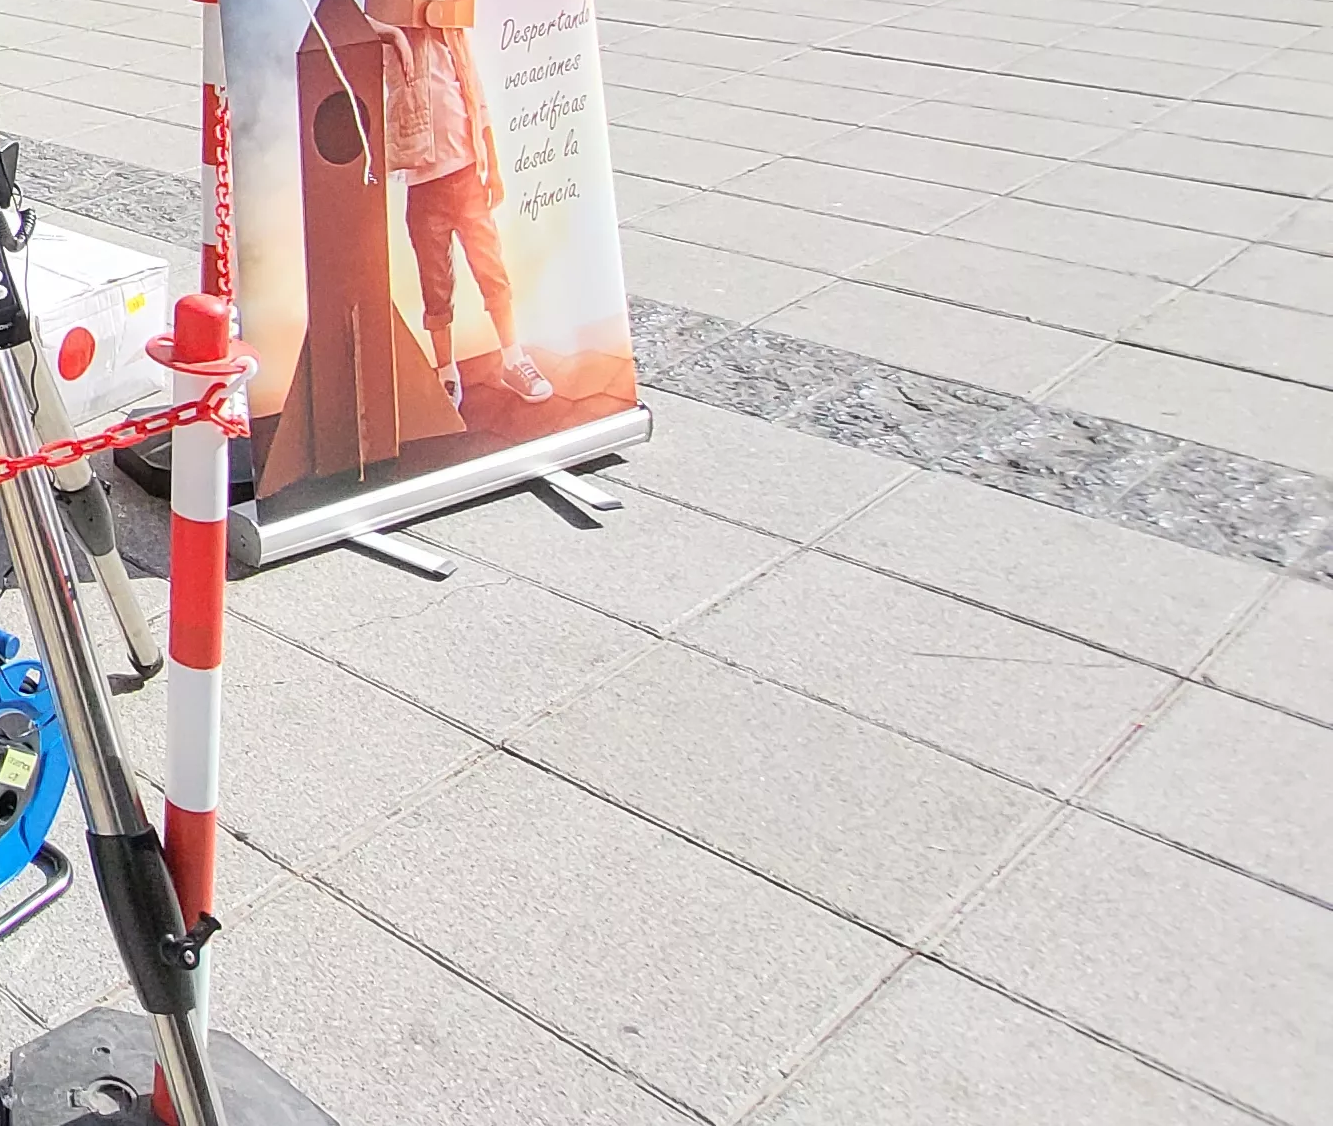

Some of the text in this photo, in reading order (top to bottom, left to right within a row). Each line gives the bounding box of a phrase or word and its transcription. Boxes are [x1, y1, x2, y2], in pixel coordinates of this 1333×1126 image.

[504, 53, 582, 90] vocaciones
[509, 90, 588, 131] científicas
[514, 128, 579, 173] desde la
[519, 178, 581, 221] infancia.
